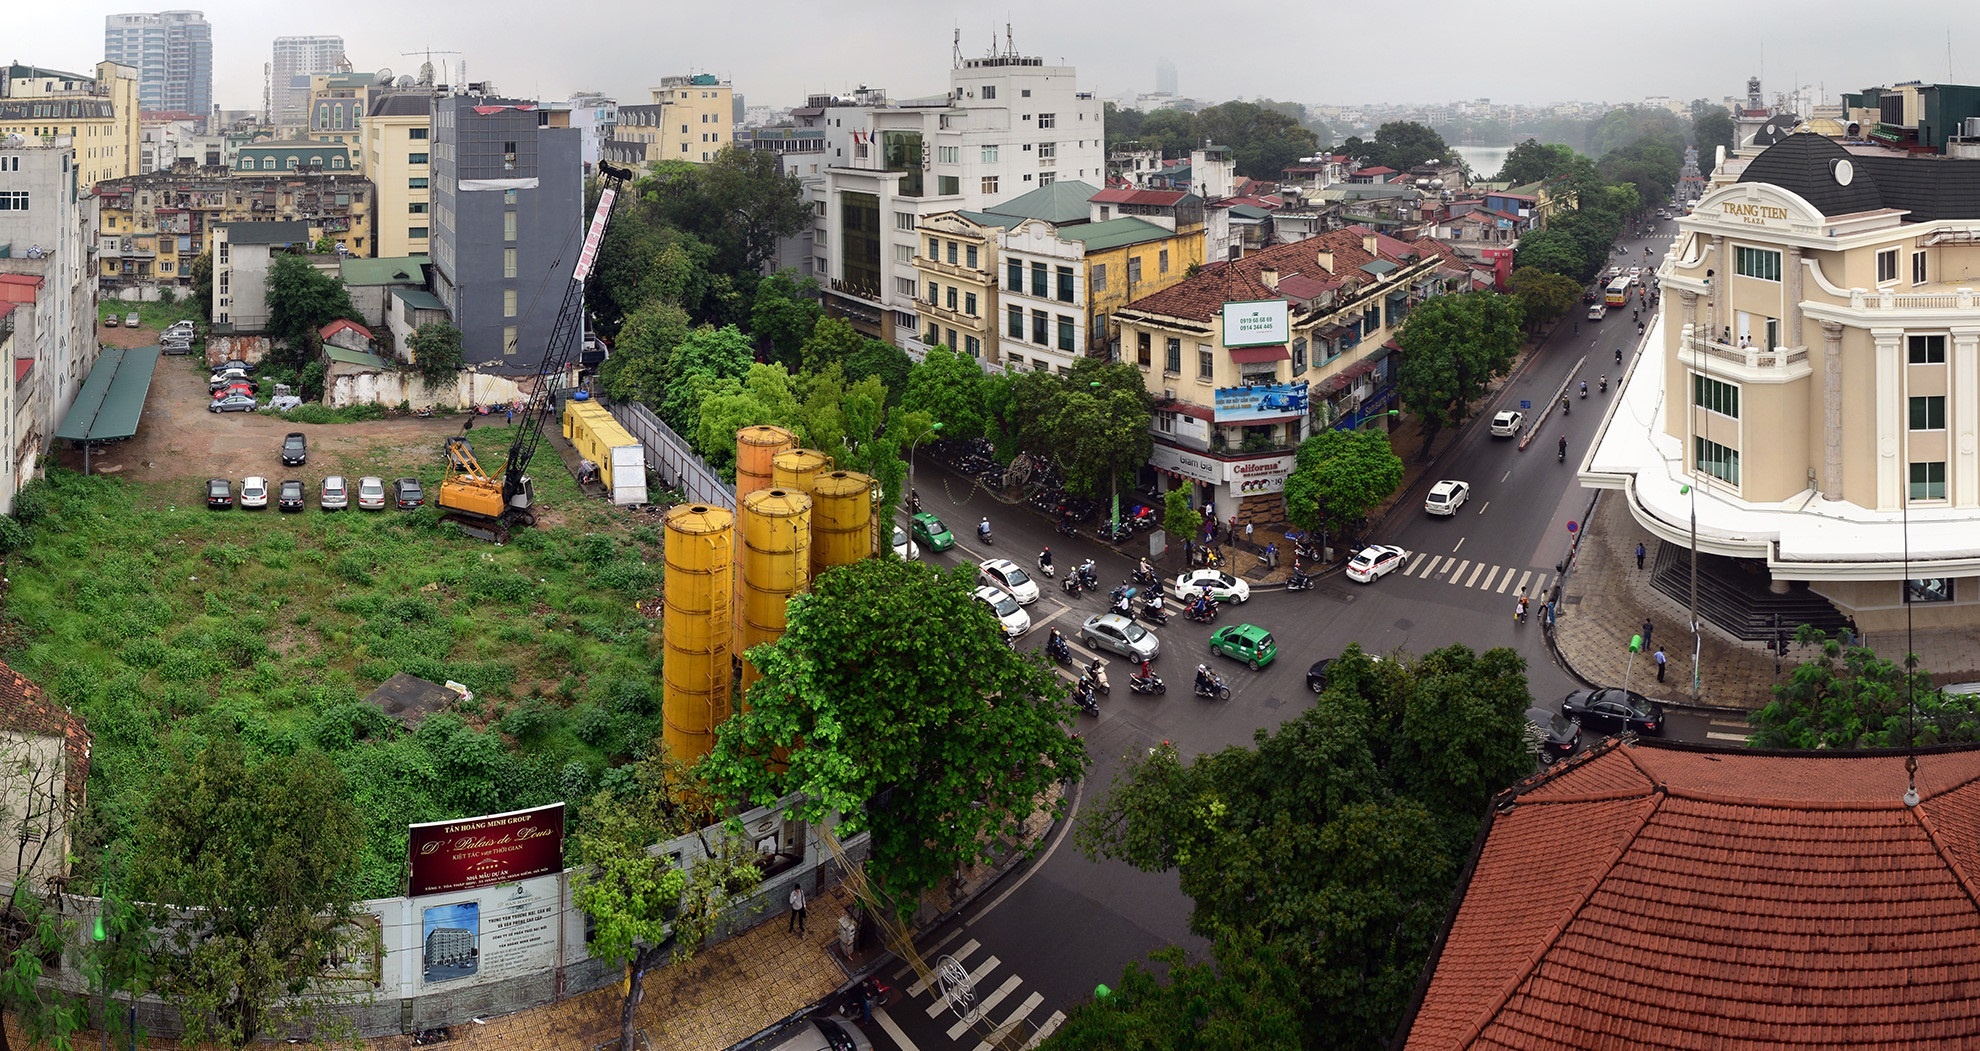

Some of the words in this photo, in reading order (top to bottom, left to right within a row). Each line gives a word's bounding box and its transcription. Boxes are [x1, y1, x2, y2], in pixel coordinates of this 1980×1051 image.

[597, 193, 614, 217] AN
[1722, 202, 1759, 216] TRANG
[1760, 206, 1788, 220] TIEN
[1743, 217, 1766, 225] PLAZA
[1233, 463, 1278, 474] California
[444, 825, 460, 833] TÂN
[461, 822, 486, 832] HOÀNG
[487, 819, 507, 828] MINH
[507, 815, 532, 824] GROUP
[453, 836, 495, 851] Palais
[497, 833, 512, 845] de
[514, 826, 554, 841] Louis
[507, 844, 523, 852] GIAN
